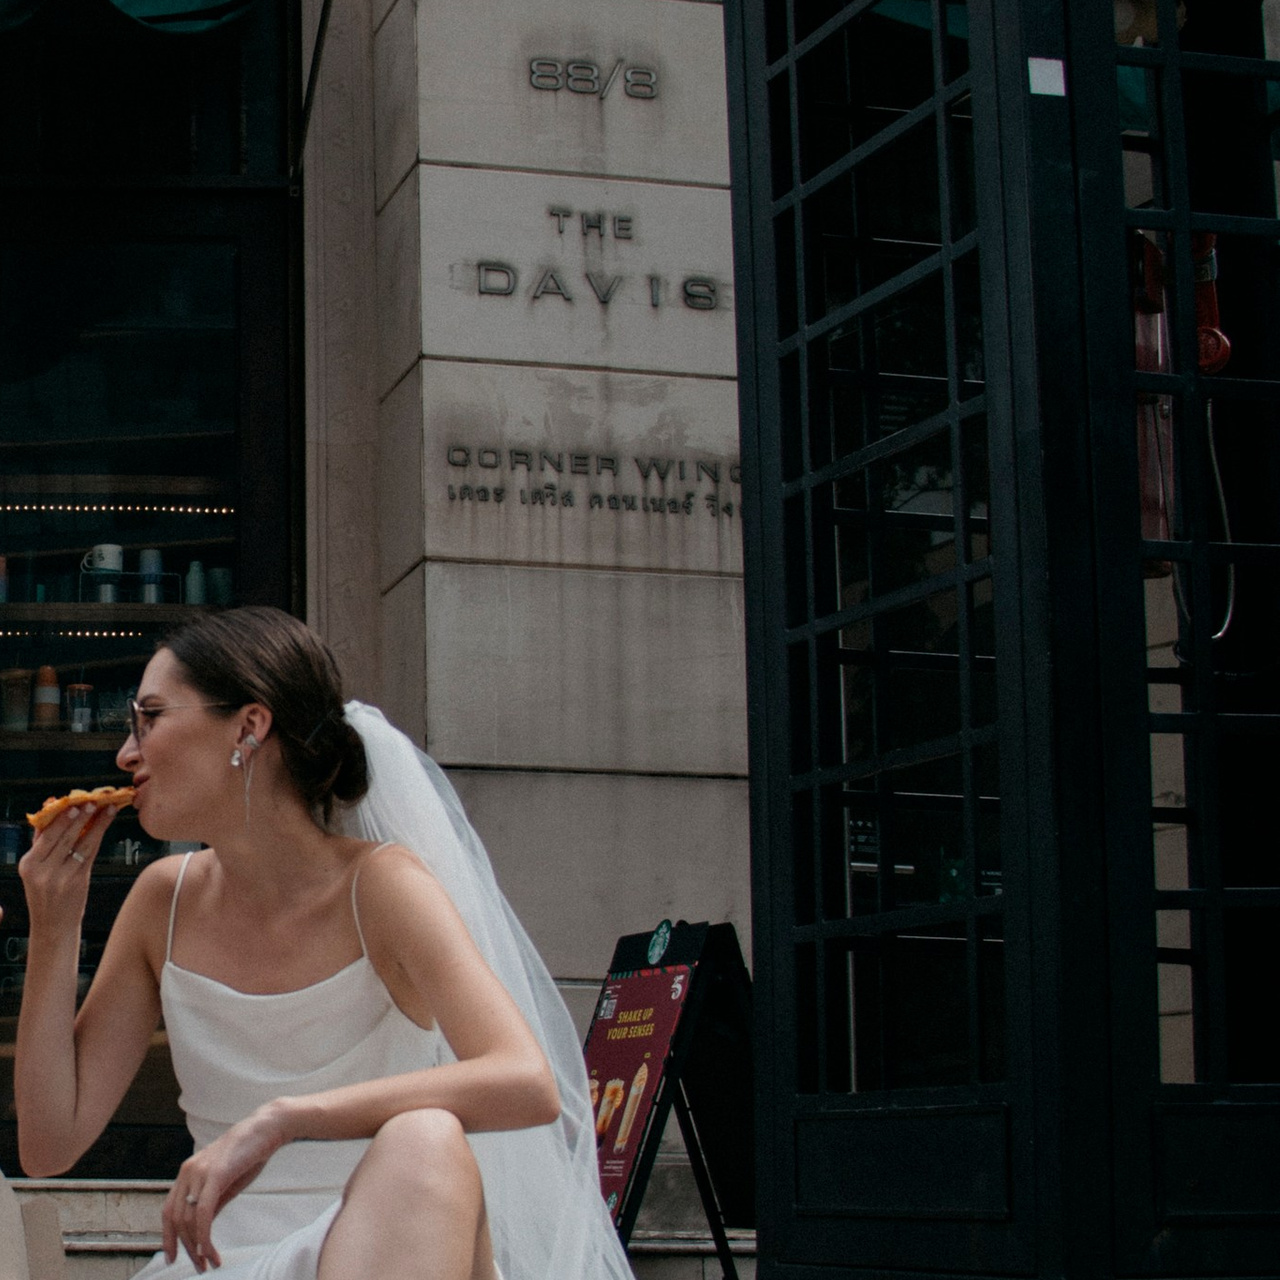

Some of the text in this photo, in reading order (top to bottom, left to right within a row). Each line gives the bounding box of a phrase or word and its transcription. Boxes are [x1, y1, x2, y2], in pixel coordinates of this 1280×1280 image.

[530, 58, 658, 100] 88/8
[549, 205, 633, 239] THE
[477, 263, 717, 310] DAVIS
[447, 446, 619, 476] CORNER
[607, 1023, 655, 1040] YOUR SENSES
[617, 1007, 654, 1024] SHAKE UP
